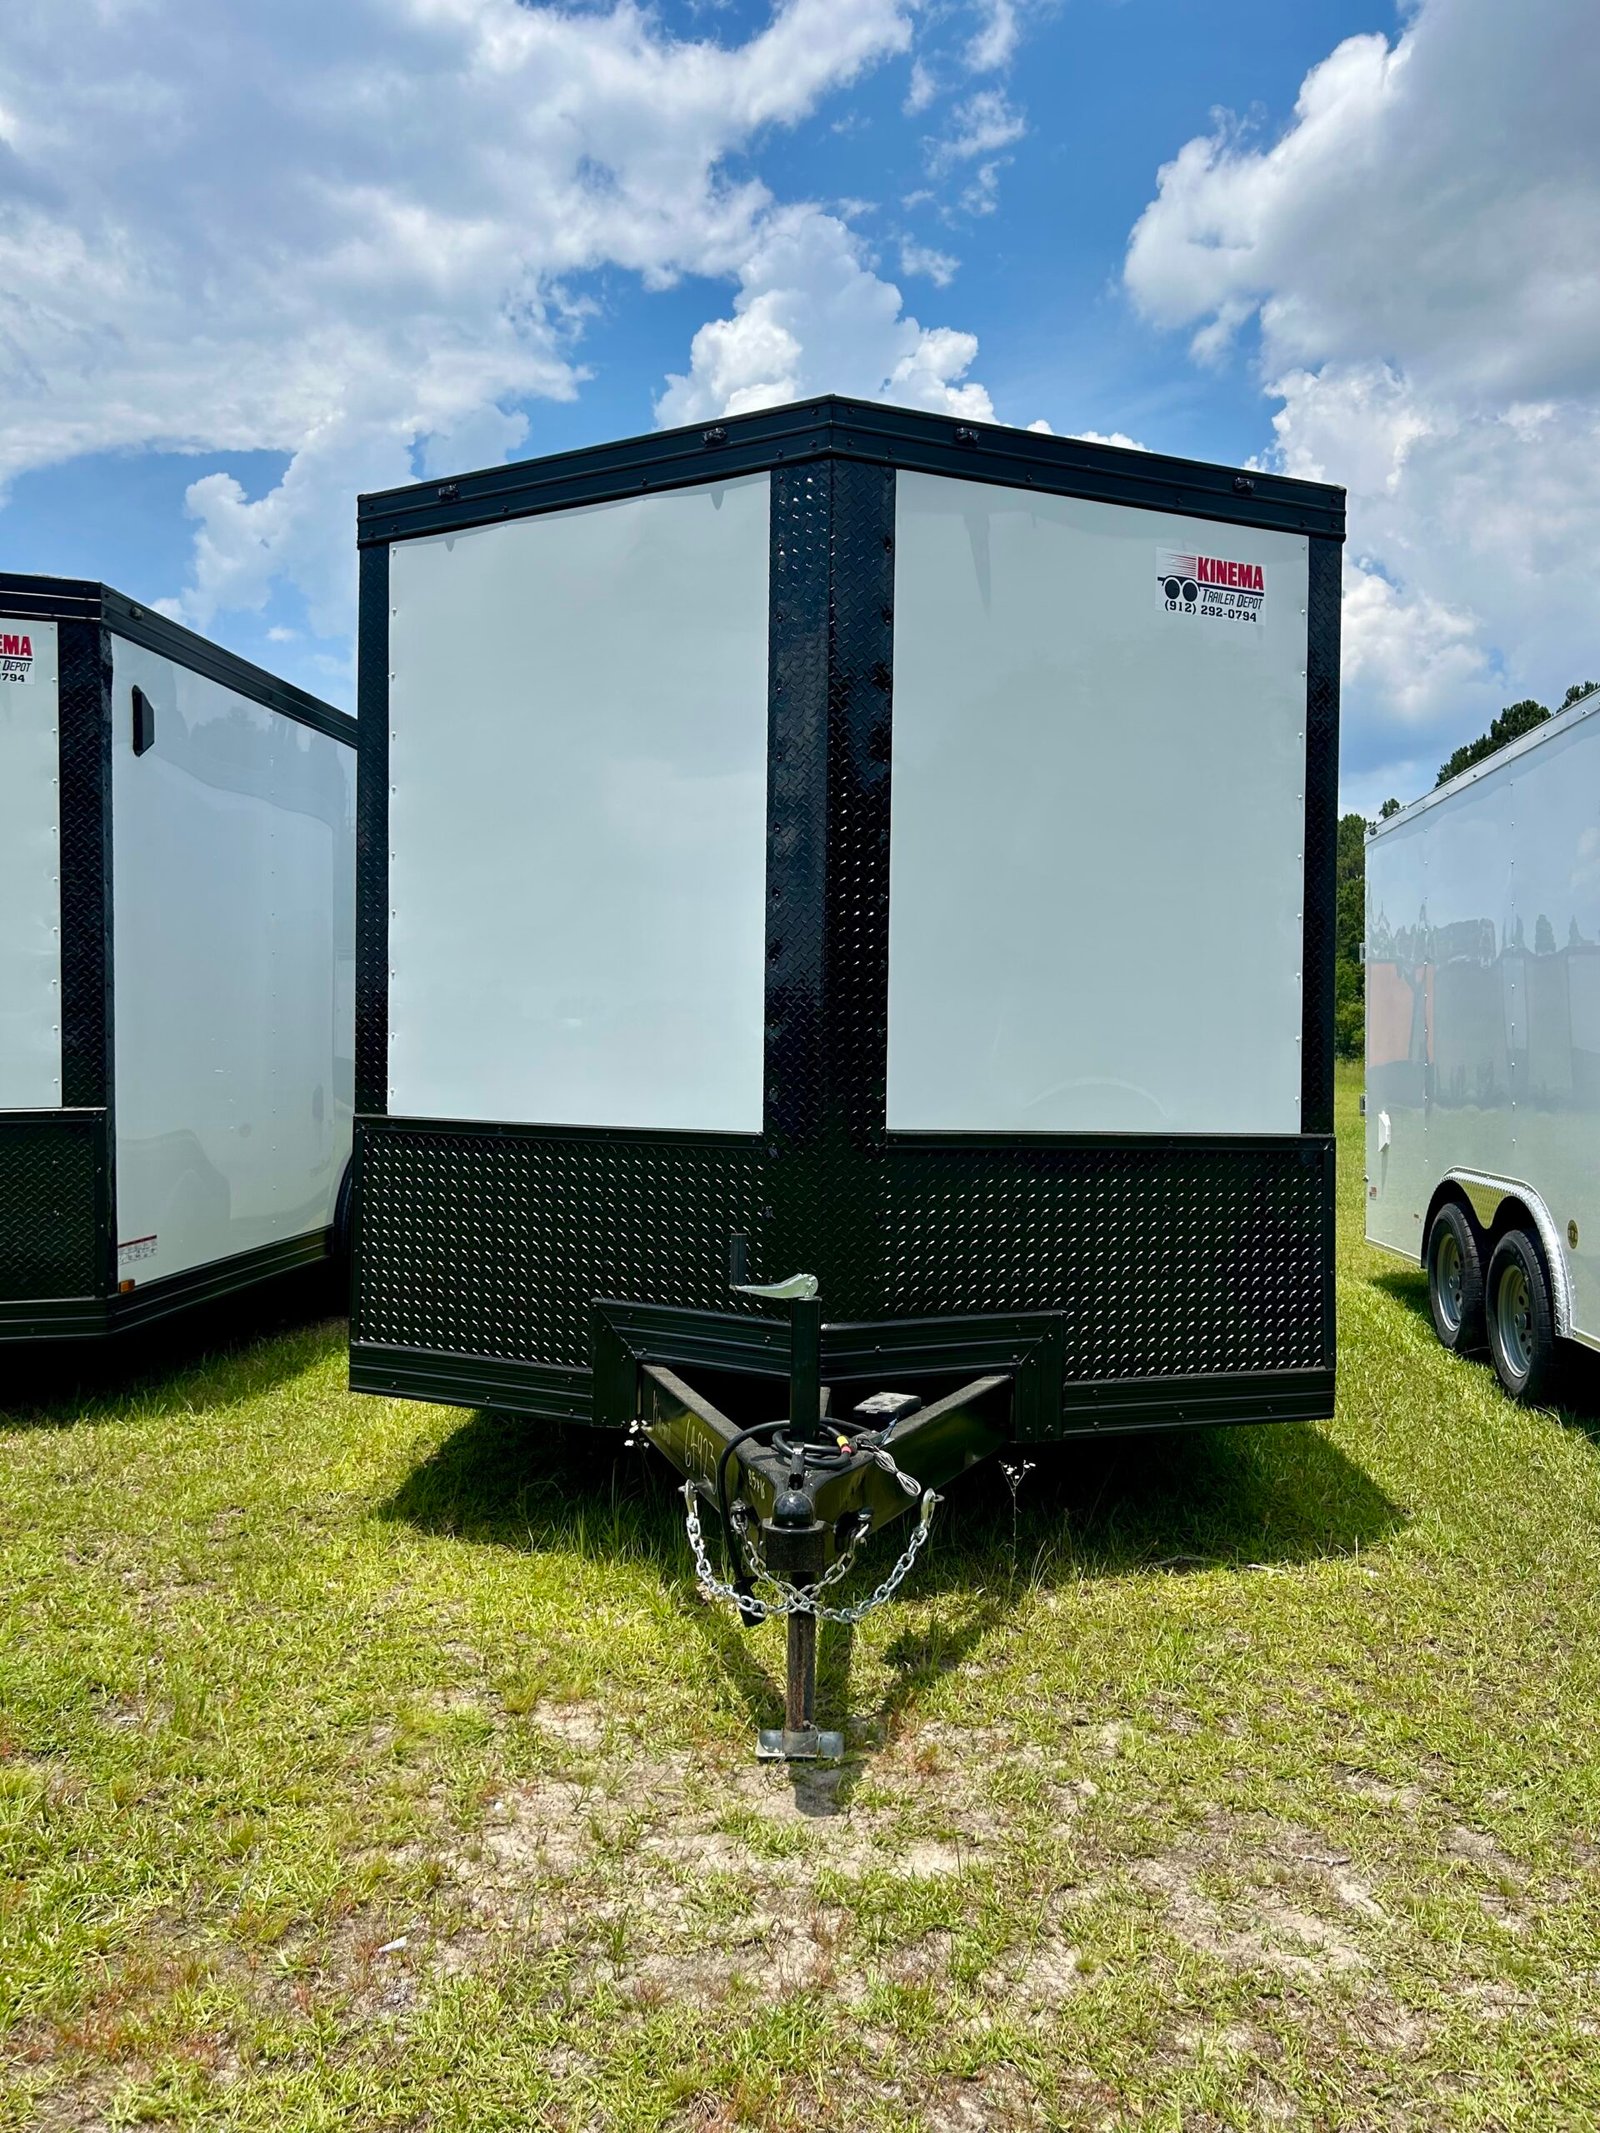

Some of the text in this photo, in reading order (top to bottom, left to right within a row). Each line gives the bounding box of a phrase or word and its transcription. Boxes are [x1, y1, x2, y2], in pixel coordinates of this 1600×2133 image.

[1197, 556, 1264, 591] KINEMA
[1202, 588, 1263, 610] TRAILER DEPOT
[1165, 600, 1257, 622] (912) 292-0794
[0, 633, 33, 657] MA
[2, 659, 32, 672] DEPOT
[0, 672, 25, 683] 794
